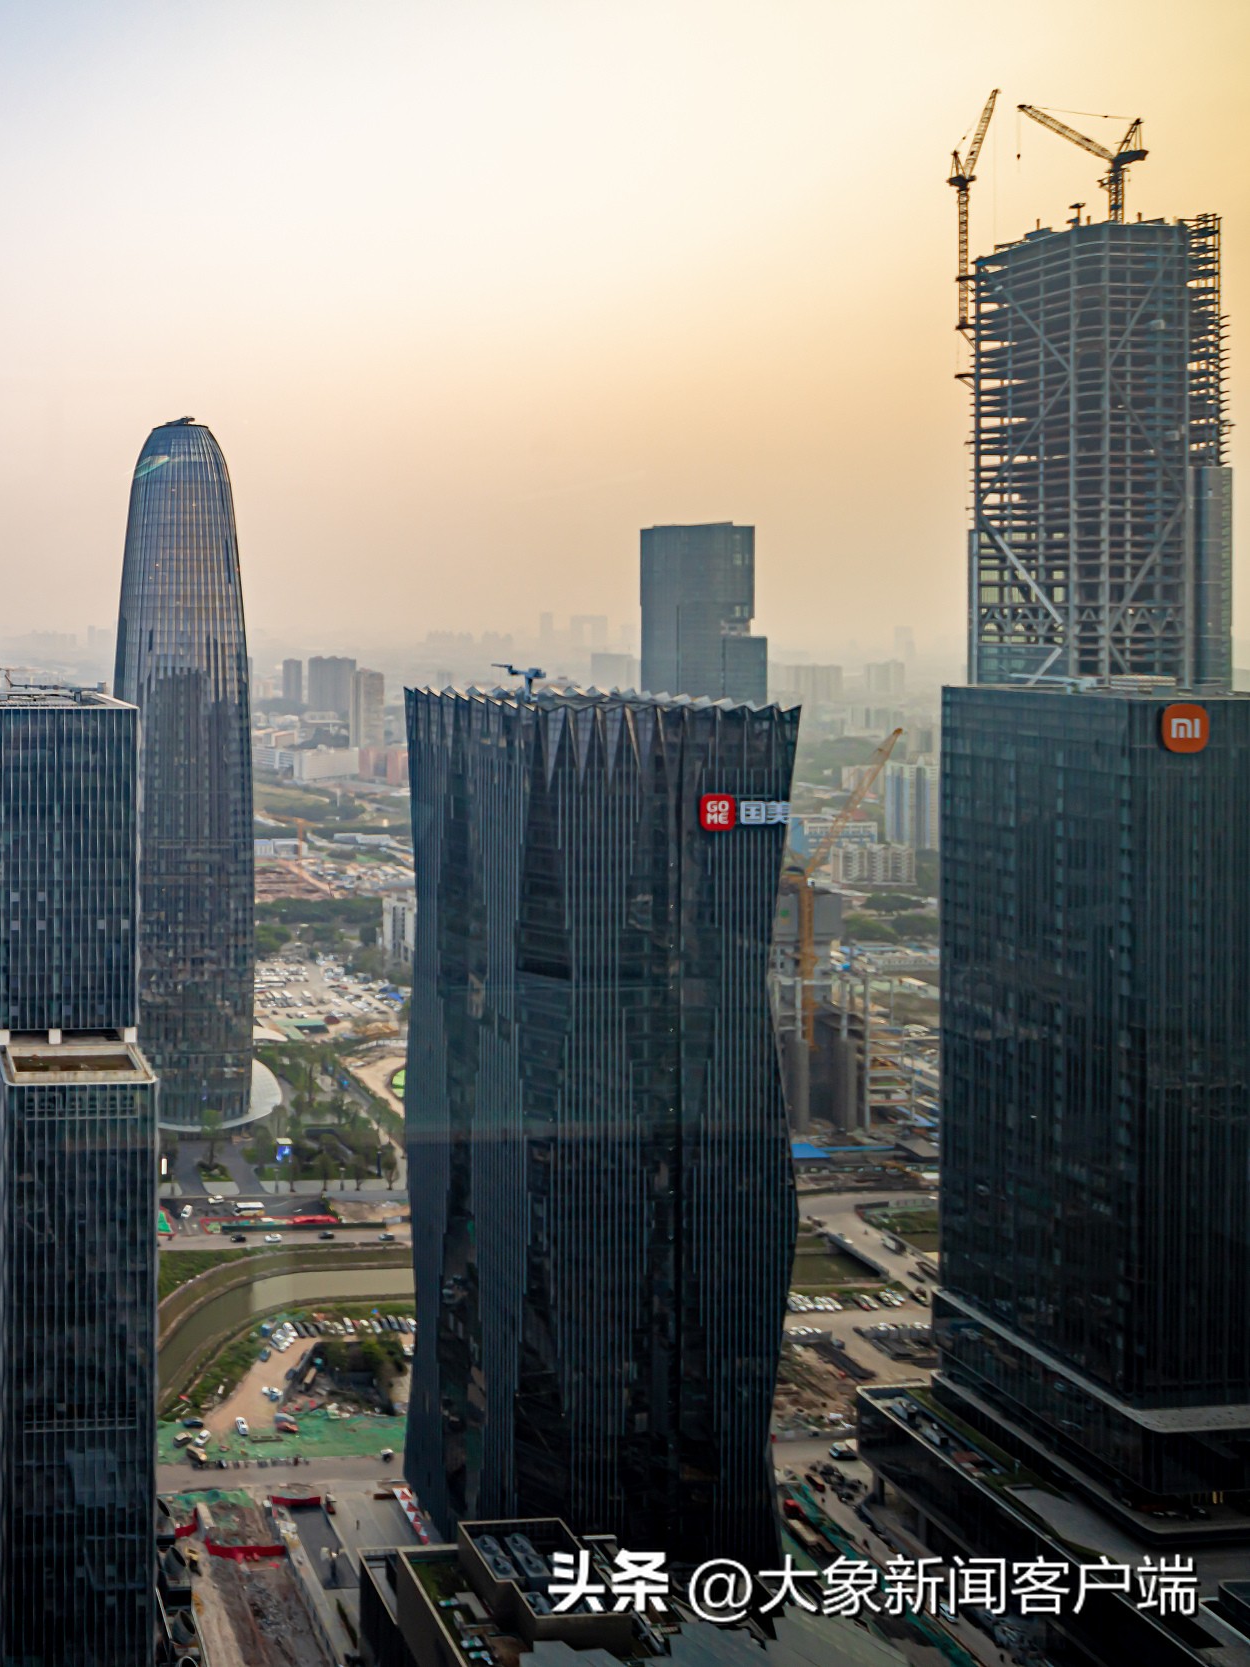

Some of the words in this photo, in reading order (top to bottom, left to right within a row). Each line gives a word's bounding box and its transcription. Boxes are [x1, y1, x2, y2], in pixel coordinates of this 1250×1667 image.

[706, 800, 730, 813] GO
[740, 800, 791, 825] 国美
[706, 812, 729, 825] ME
